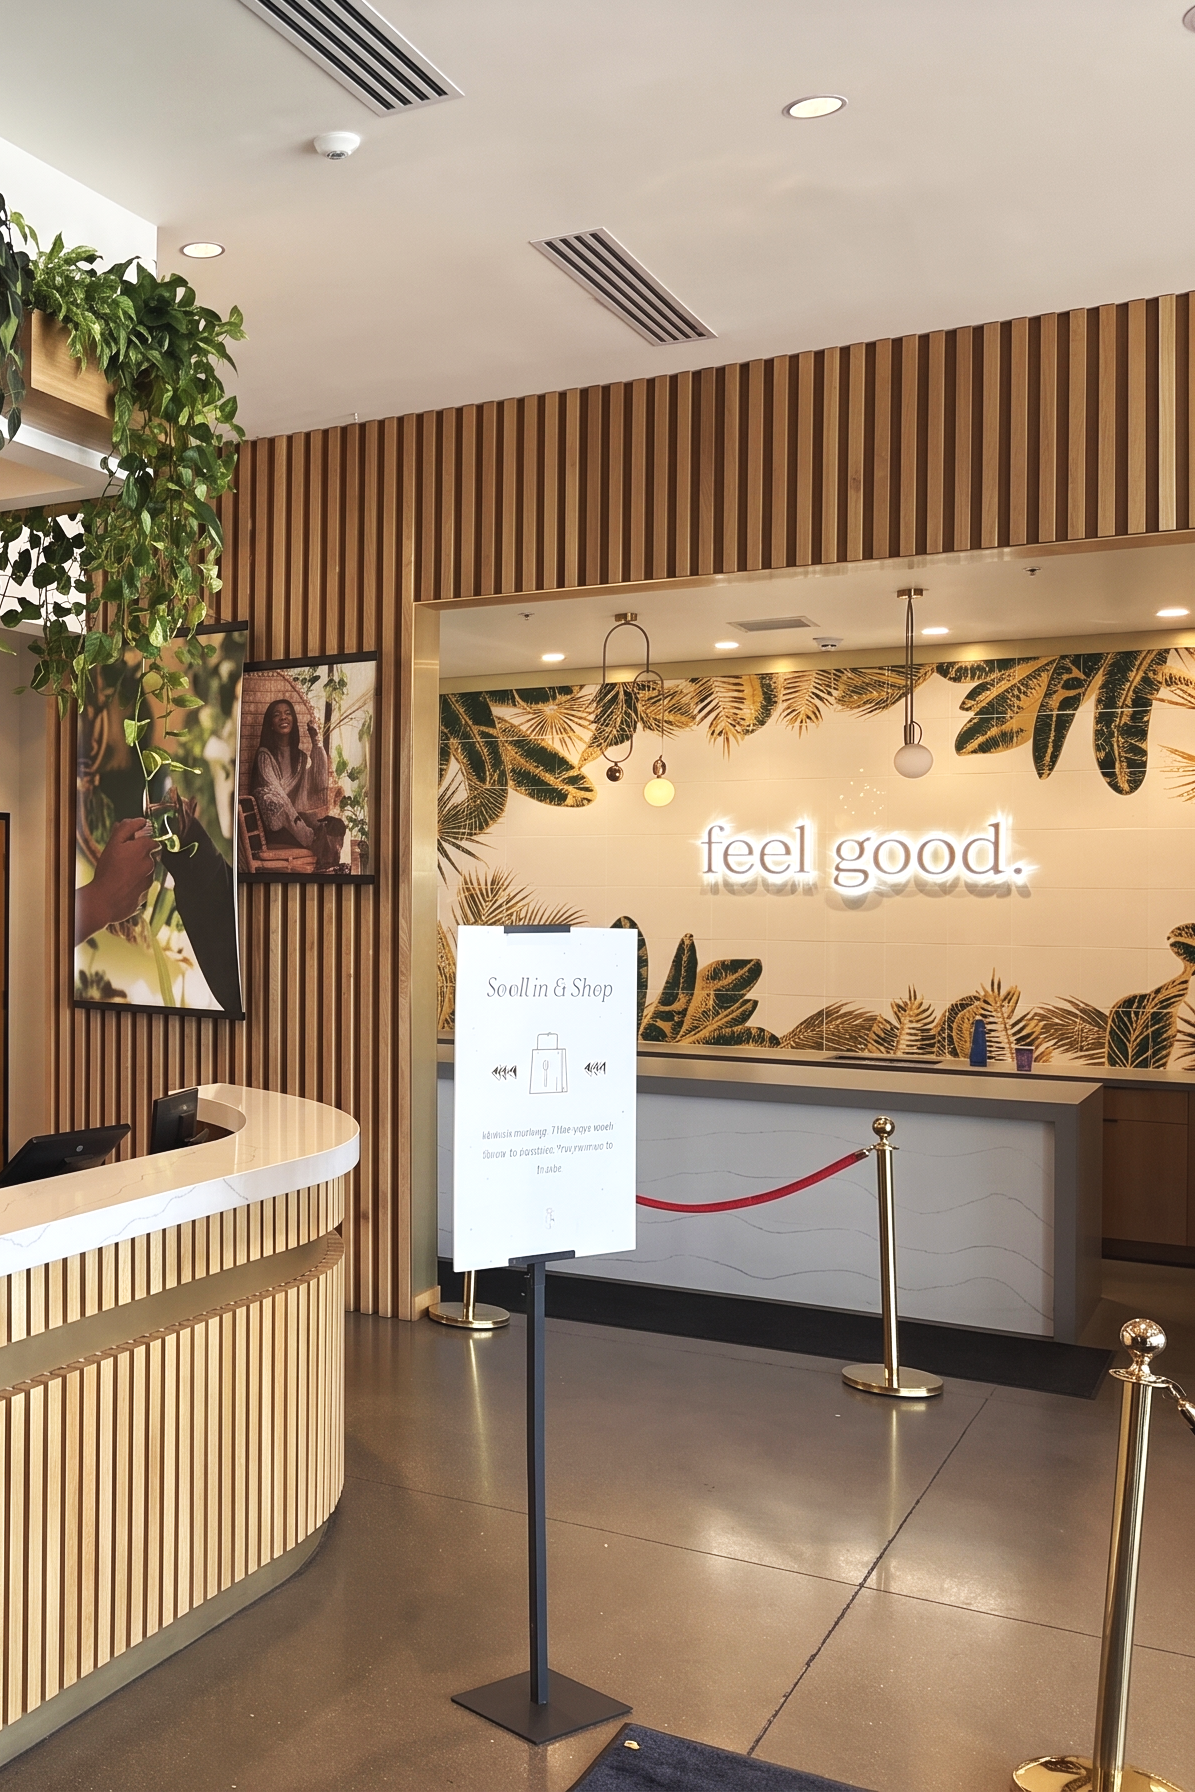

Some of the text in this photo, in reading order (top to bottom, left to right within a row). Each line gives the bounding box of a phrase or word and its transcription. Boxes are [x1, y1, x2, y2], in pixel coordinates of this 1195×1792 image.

[700, 821, 1023, 889] feel good.
[553, 977, 567, 998] &
[570, 977, 614, 1003] Shop
